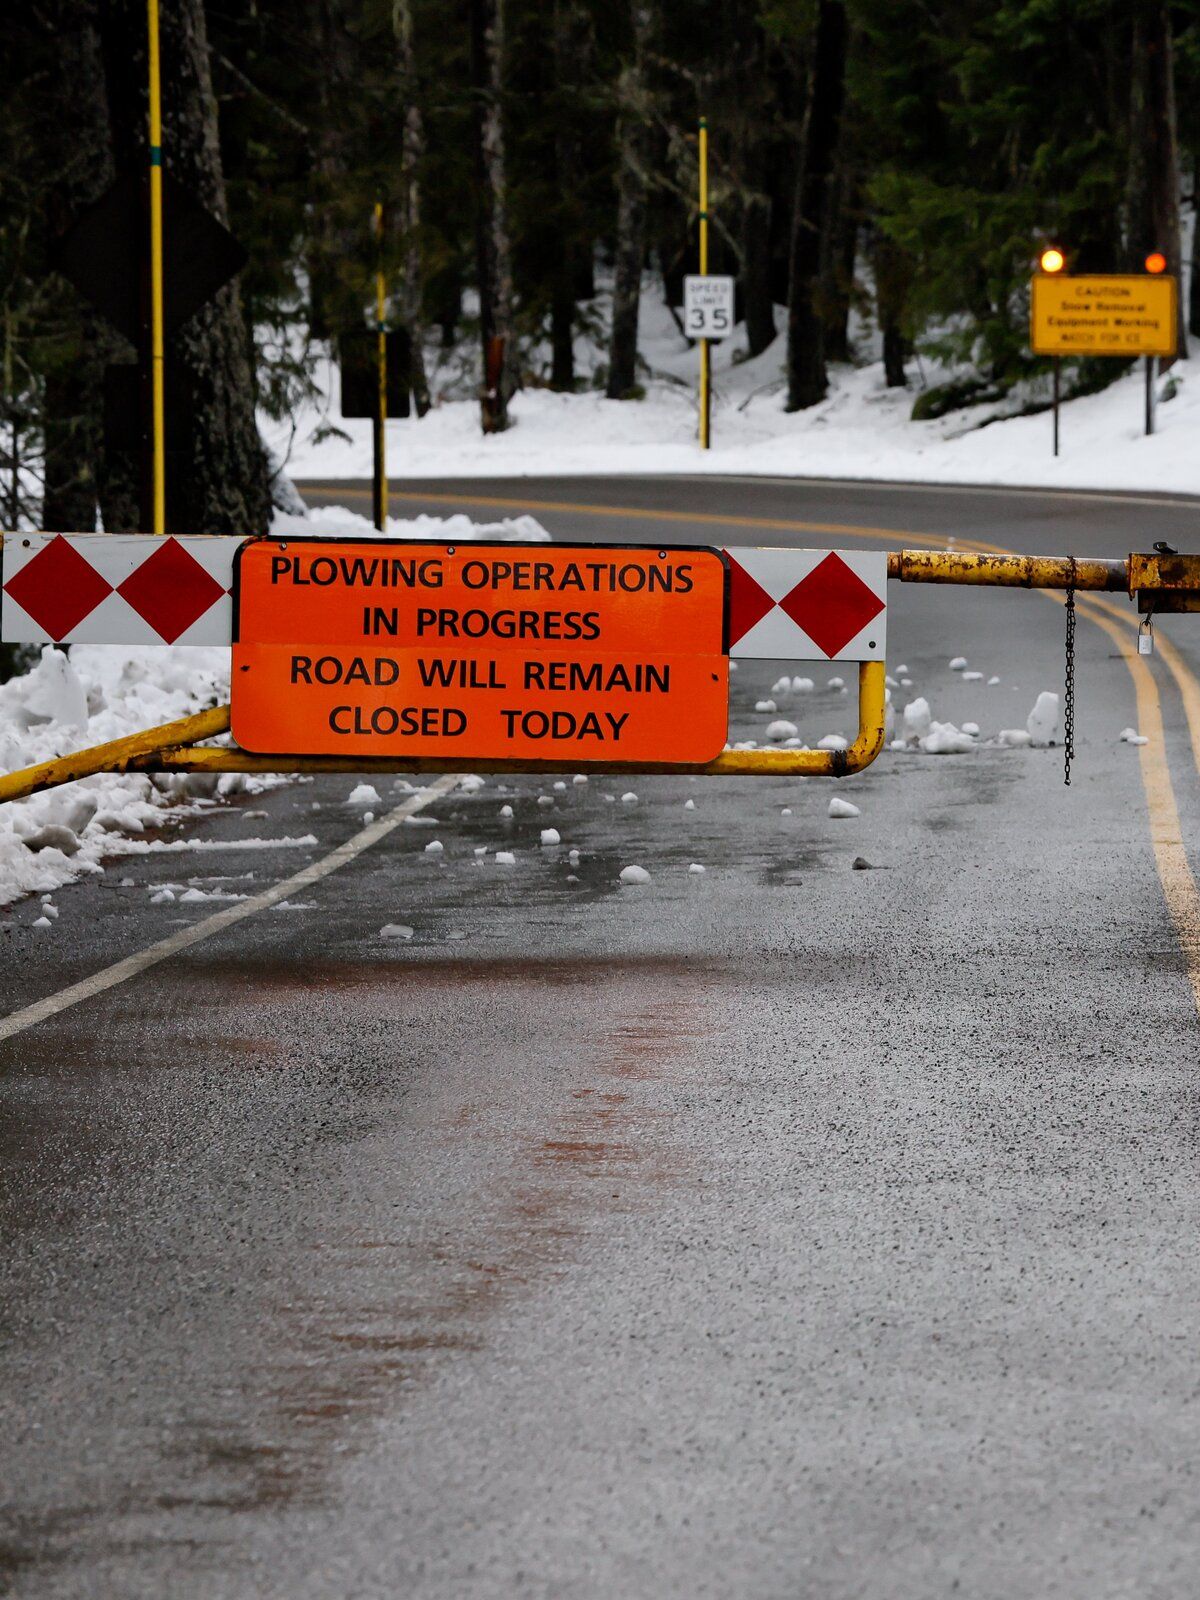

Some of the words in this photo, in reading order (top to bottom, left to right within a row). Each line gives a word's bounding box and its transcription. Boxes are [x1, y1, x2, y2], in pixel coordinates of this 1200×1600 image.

[1075, 286, 1131, 297] CAUTION
[690, 308, 729, 330] 35
[271, 556, 443, 588] PLOWING
[461, 561, 694, 593] OPERATIONS
[363, 607, 399, 636] IN
[416, 608, 601, 641] PROGRESS
[290, 655, 400, 686] ROAD
[417, 658, 507, 689] WILL
[523, 661, 670, 693] REMAIN
[328, 705, 467, 737] CLOSED
[500, 709, 630, 741] TODAY
